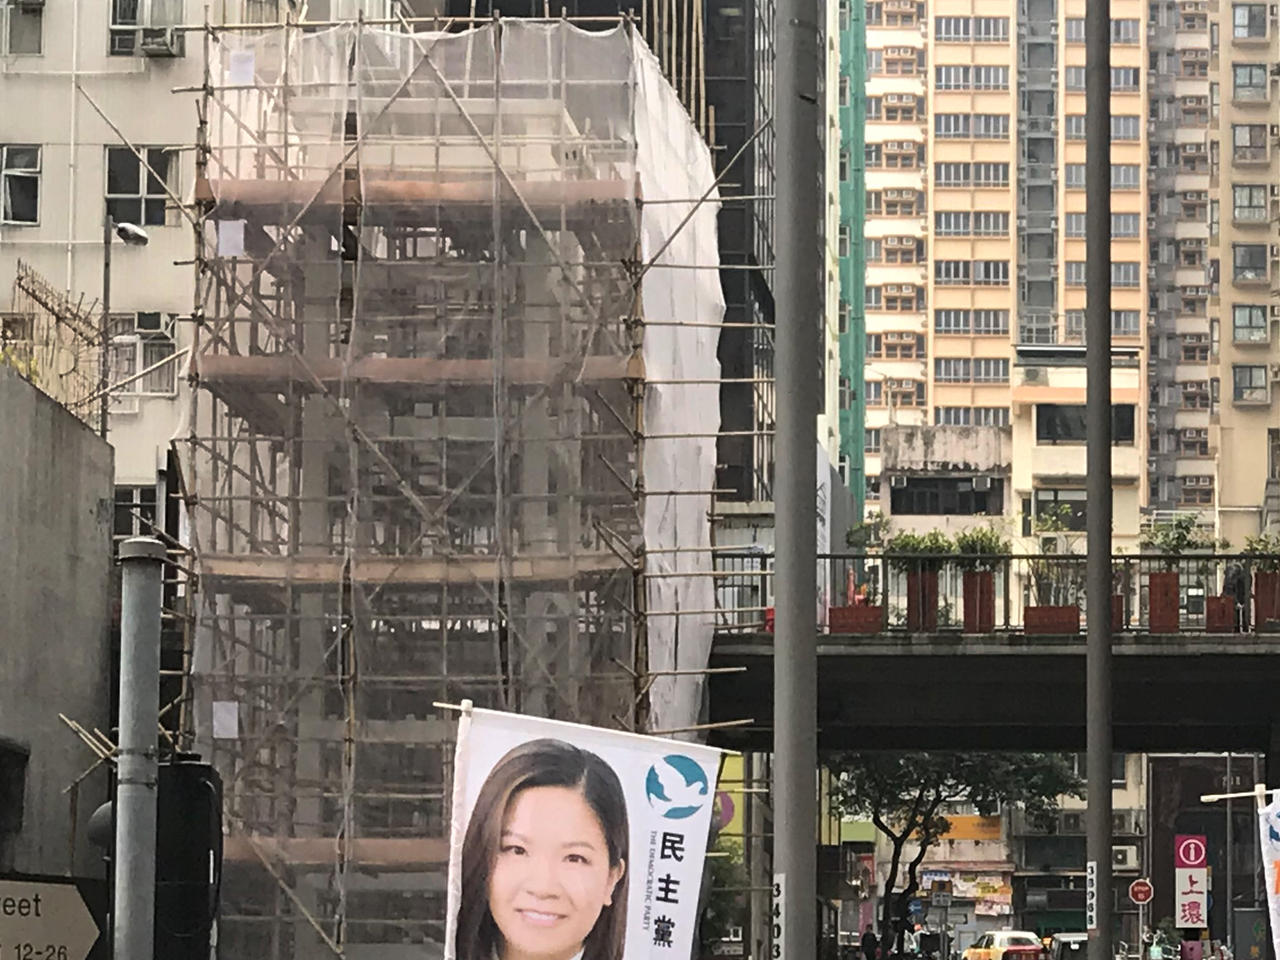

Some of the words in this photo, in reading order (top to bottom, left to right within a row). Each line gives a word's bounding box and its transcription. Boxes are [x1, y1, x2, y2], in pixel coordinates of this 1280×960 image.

[0, 893, 42, 917] eet
[652, 831, 685, 948] 民主黨
[1181, 874, 1204, 924] 上環
